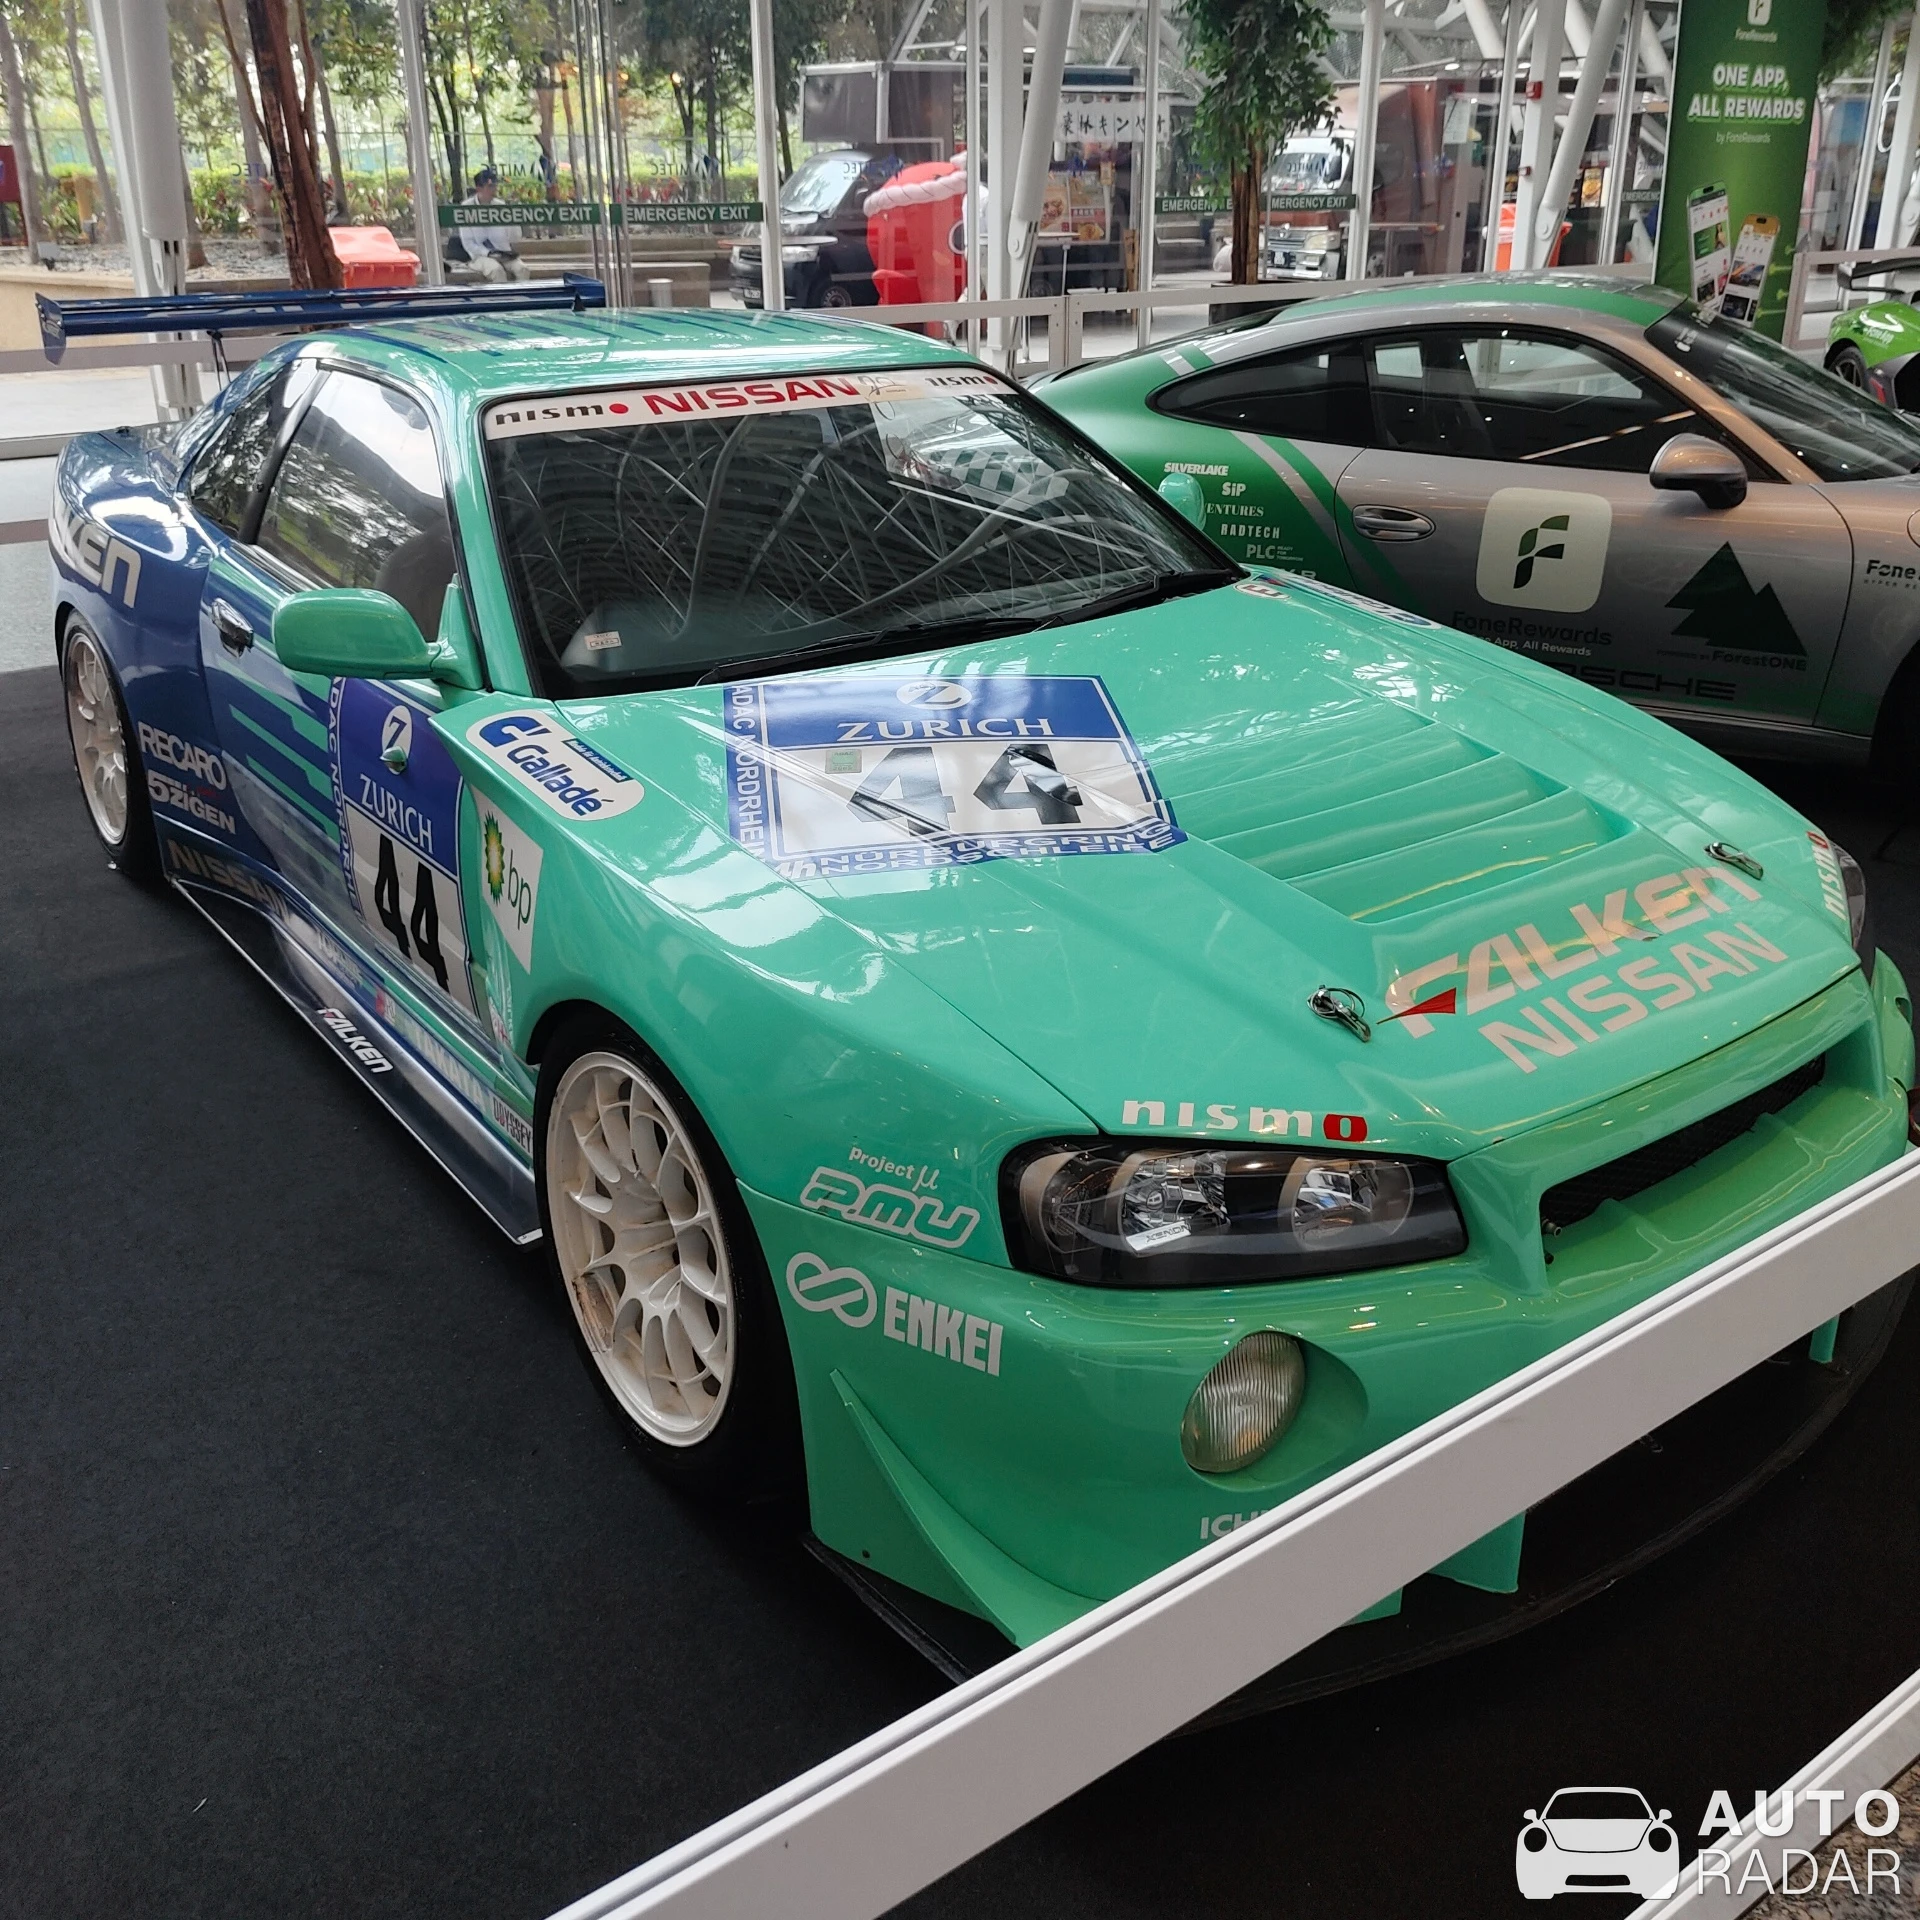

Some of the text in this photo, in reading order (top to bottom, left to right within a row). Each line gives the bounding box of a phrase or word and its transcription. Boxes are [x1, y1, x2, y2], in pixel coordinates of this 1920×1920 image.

[1713, 63, 1789, 91] ONE APP,
[1688, 94, 1806, 120] ALL REWARDS
[453, 206, 593, 225] EMERGENCY EXIT
[626, 206, 750, 223] EMERGENCY EXIT
[1268, 196, 1348, 209] MERGENCY EXIT
[642, 375, 862, 416] NISSAN
[1164, 462, 1229, 477] SILVERLAKE
[1204, 503, 1265, 518] ENTURES
[1221, 523, 1280, 539] RADTECH
[1246, 543, 1276, 560] PLC
[1866, 559, 1920, 581] Fone
[1451, 611, 1613, 646] FoneRewards
[1522, 638, 1539, 651] All
[1541, 641, 1592, 657] Rewards
[1712, 650, 1808, 672] ForestONE
[732, 686, 756, 731] ADAC
[836, 717, 1055, 741] ZURICH
[138, 721, 227, 791] RECARO
[846, 743, 1085, 838] 44
[359, 773, 434, 856] ZURICH
[820, 834, 1177, 875] NORDSCHLEIFE
[507, 848, 533, 931] bp
[1806, 830, 1847, 921] nismo
[374, 833, 450, 994] 44
[1384, 866, 1764, 1039] FALKEN
[1478, 922, 1789, 1075] NISSAN
[317, 1007, 394, 1075] FALKEN
[493, 1096, 532, 1154] ODYSSEY
[1122, 1099, 1368, 1142] nismo
[849, 1145, 915, 1181] project
[1144, 1221, 1192, 1245] XENON
[883, 1285, 1004, 1378] ENKEI
